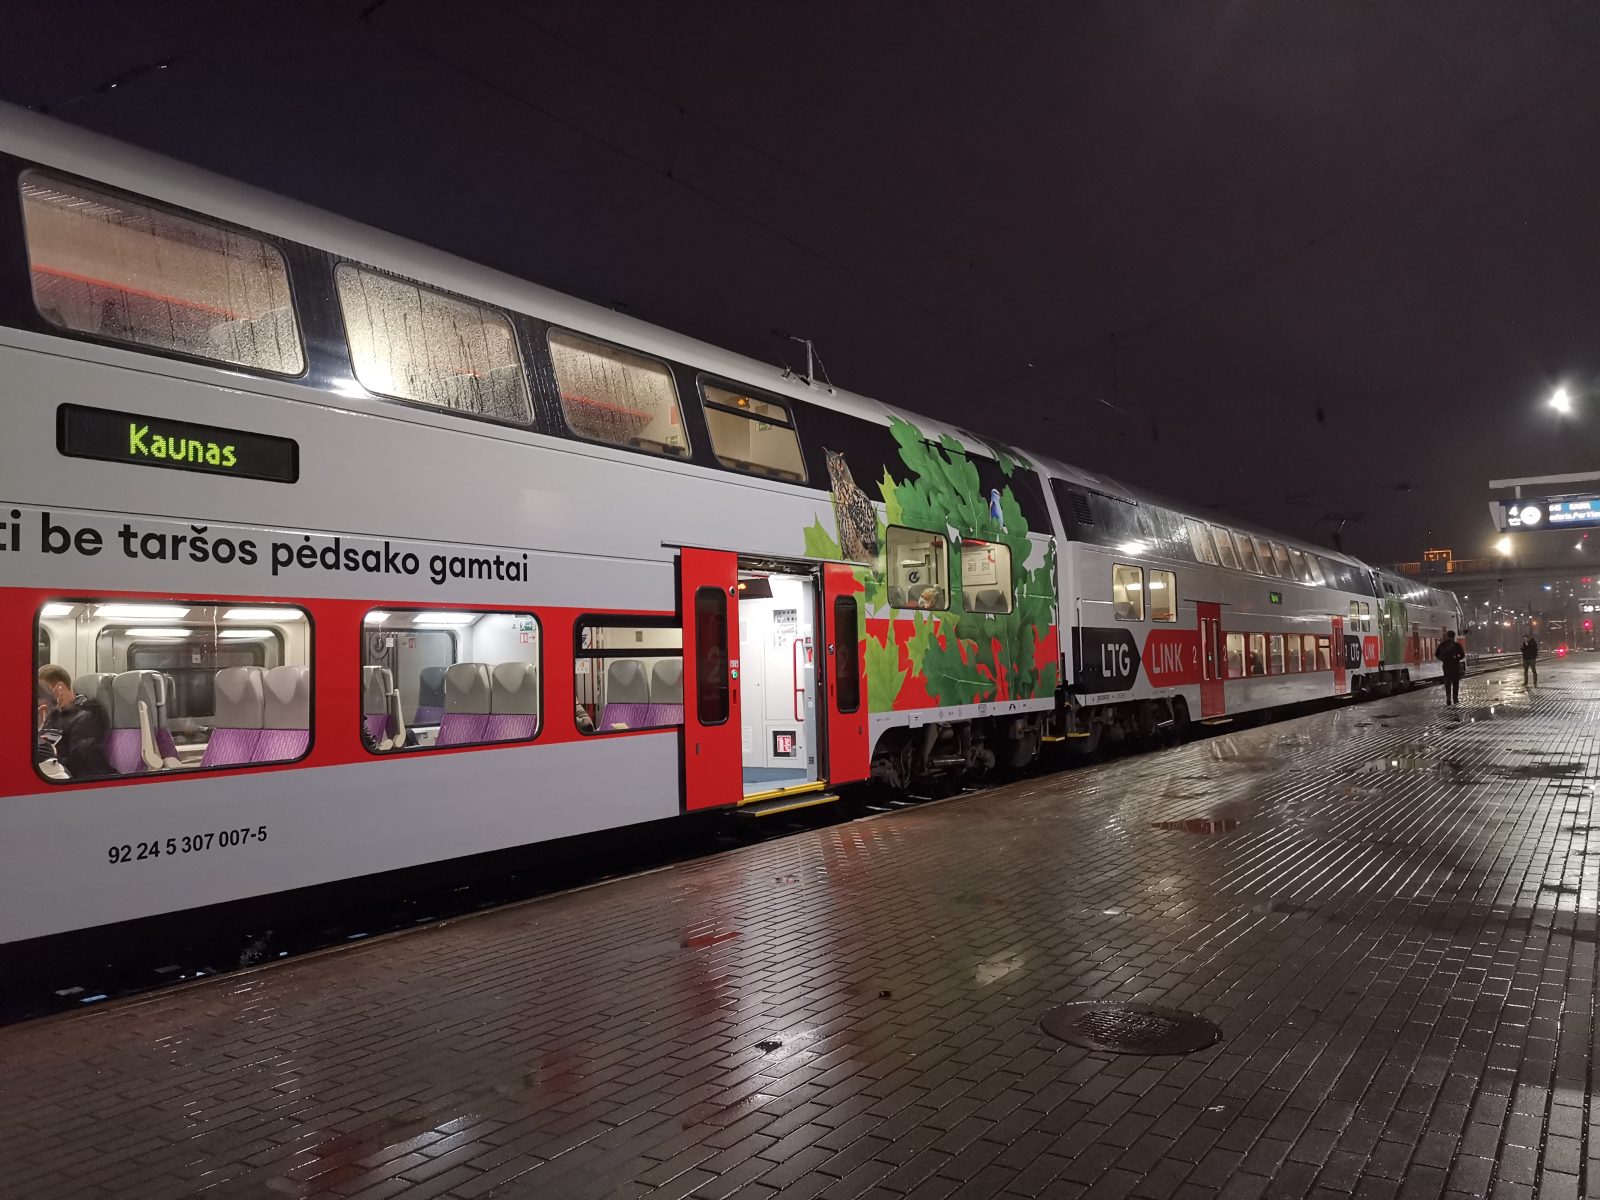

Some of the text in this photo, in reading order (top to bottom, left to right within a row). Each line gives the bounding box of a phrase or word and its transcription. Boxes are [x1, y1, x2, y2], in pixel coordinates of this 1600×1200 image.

[129, 423, 237, 467] Kaunas
[1508, 506, 1518, 516] 4
[41, 511, 103, 556] be
[118, 524, 258, 565] taršos
[271, 535, 420, 576] pėdsako
[429, 553, 528, 585] gamtai
[1101, 643, 1131, 677] LTG
[1151, 643, 1184, 673] LINK
[1192, 645, 1198, 664] 2
[108, 825, 268, 864] 92 24 5 307 007-5
